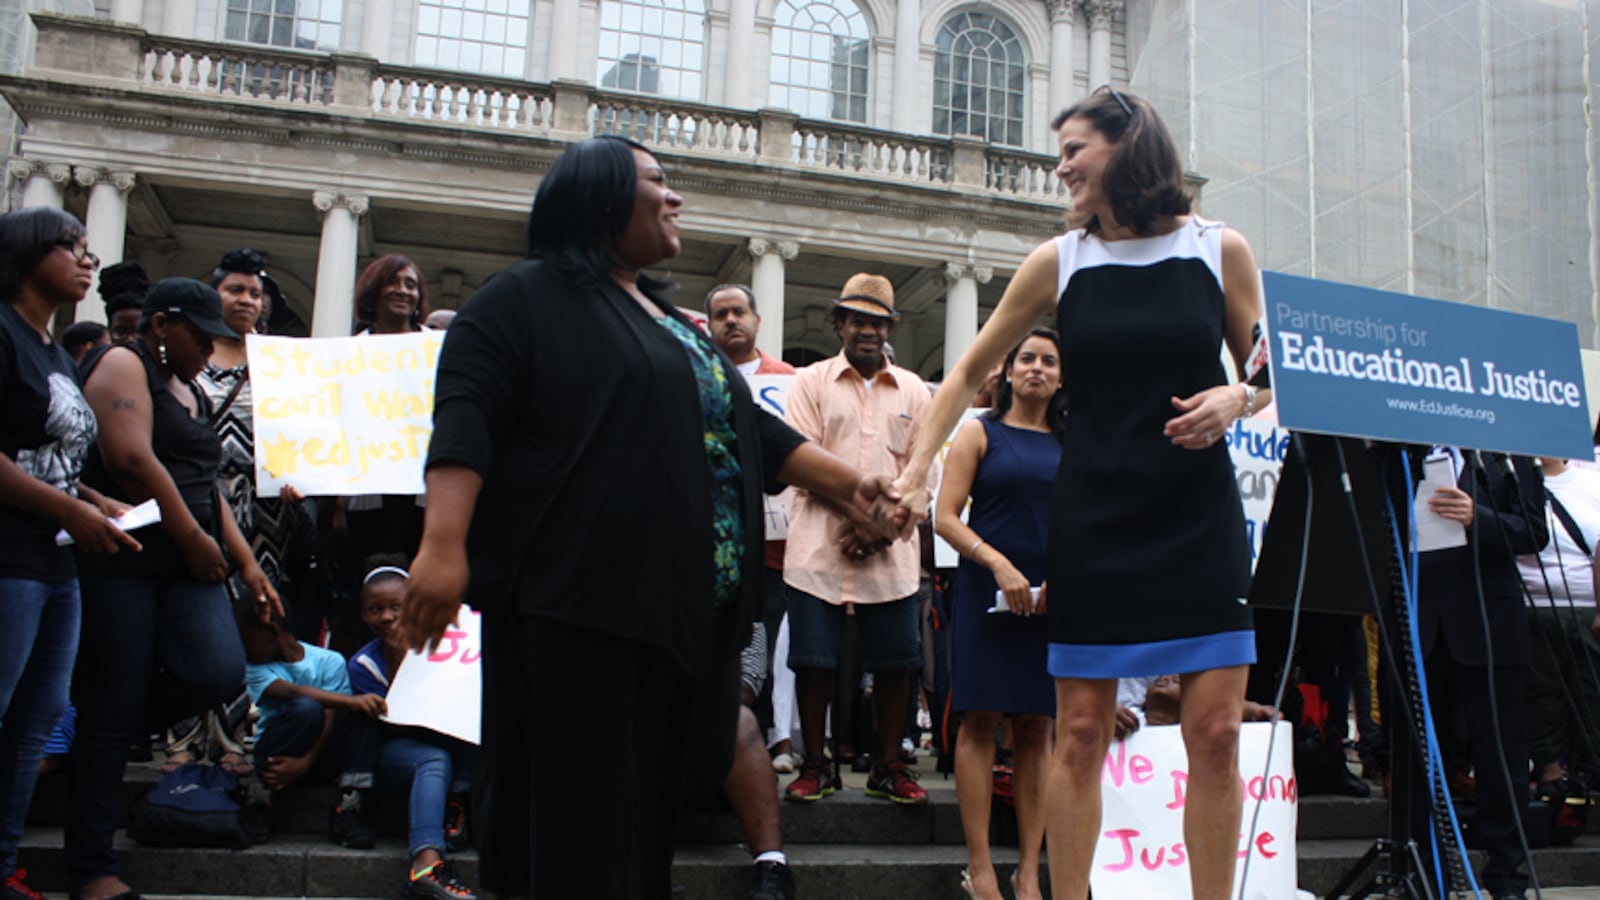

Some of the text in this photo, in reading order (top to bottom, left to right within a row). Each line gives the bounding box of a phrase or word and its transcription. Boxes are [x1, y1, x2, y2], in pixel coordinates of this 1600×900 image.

[1276, 302, 1427, 347] Partnership for
[1278, 331, 1475, 394] Educational
[1481, 362, 1580, 407] Justice
[1386, 398, 1496, 424] www.EdJustice.org
